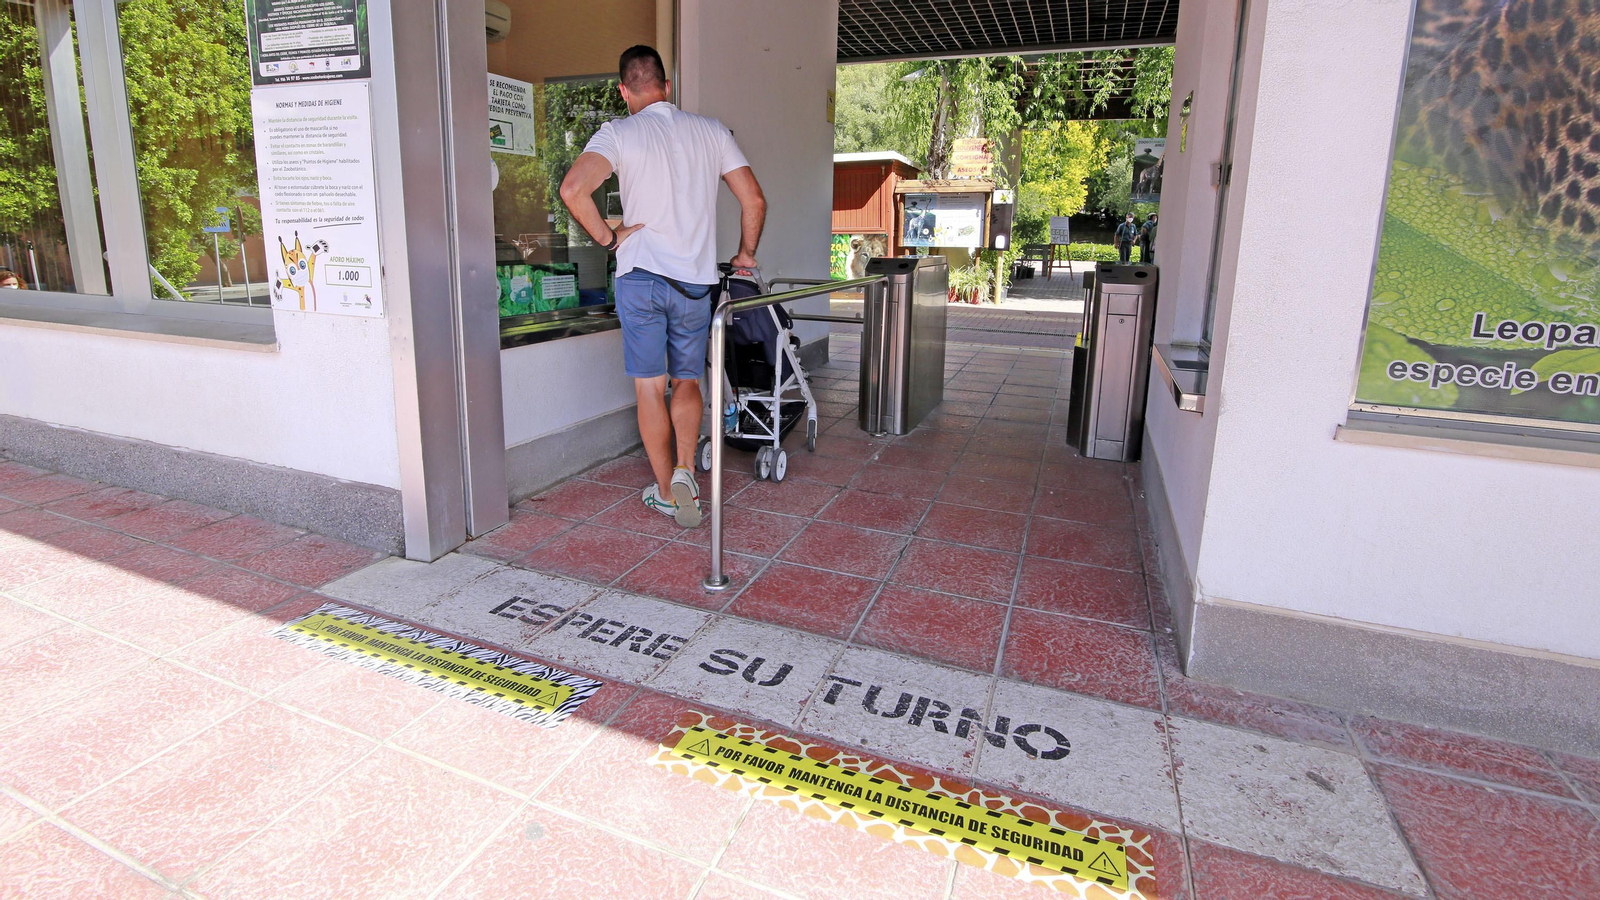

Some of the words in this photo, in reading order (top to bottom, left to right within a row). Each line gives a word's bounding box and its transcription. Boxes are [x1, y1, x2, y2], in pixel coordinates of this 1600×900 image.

[496, 81, 526, 93] RECOMIENDA
[500, 90, 512, 98] PAGO
[492, 97, 510, 106] TARJETA
[505, 108, 531, 119] PREVENTIVA
[338, 271, 359, 281] 1.000
[1472, 312, 1600, 350] Leopa
[1387, 360, 1538, 389] especie
[1549, 372, 1600, 395] en
[320, 624, 339, 634] POR
[338, 630, 368, 643] FAVOR
[365, 638, 413, 659] MANTENGA
[410, 652, 424, 661] LA
[423, 656, 474, 677] DISTANCIA
[470, 670, 486, 680] DE
[482, 674, 542, 697] SEGURIDAD
[488, 595, 688, 661] ESPERE
[699, 648, 794, 687] SU
[823, 674, 1072, 761] TURNO
[714, 746, 741, 762] POR
[742, 753, 785, 775] FAVOR
[788, 768, 863, 798] MANTENGA
[865, 790, 884, 804] LA
[884, 794, 965, 828] DISTANCIA
[968, 820, 988, 836] DE
[990, 825, 1084, 862] SEGURIDAD
